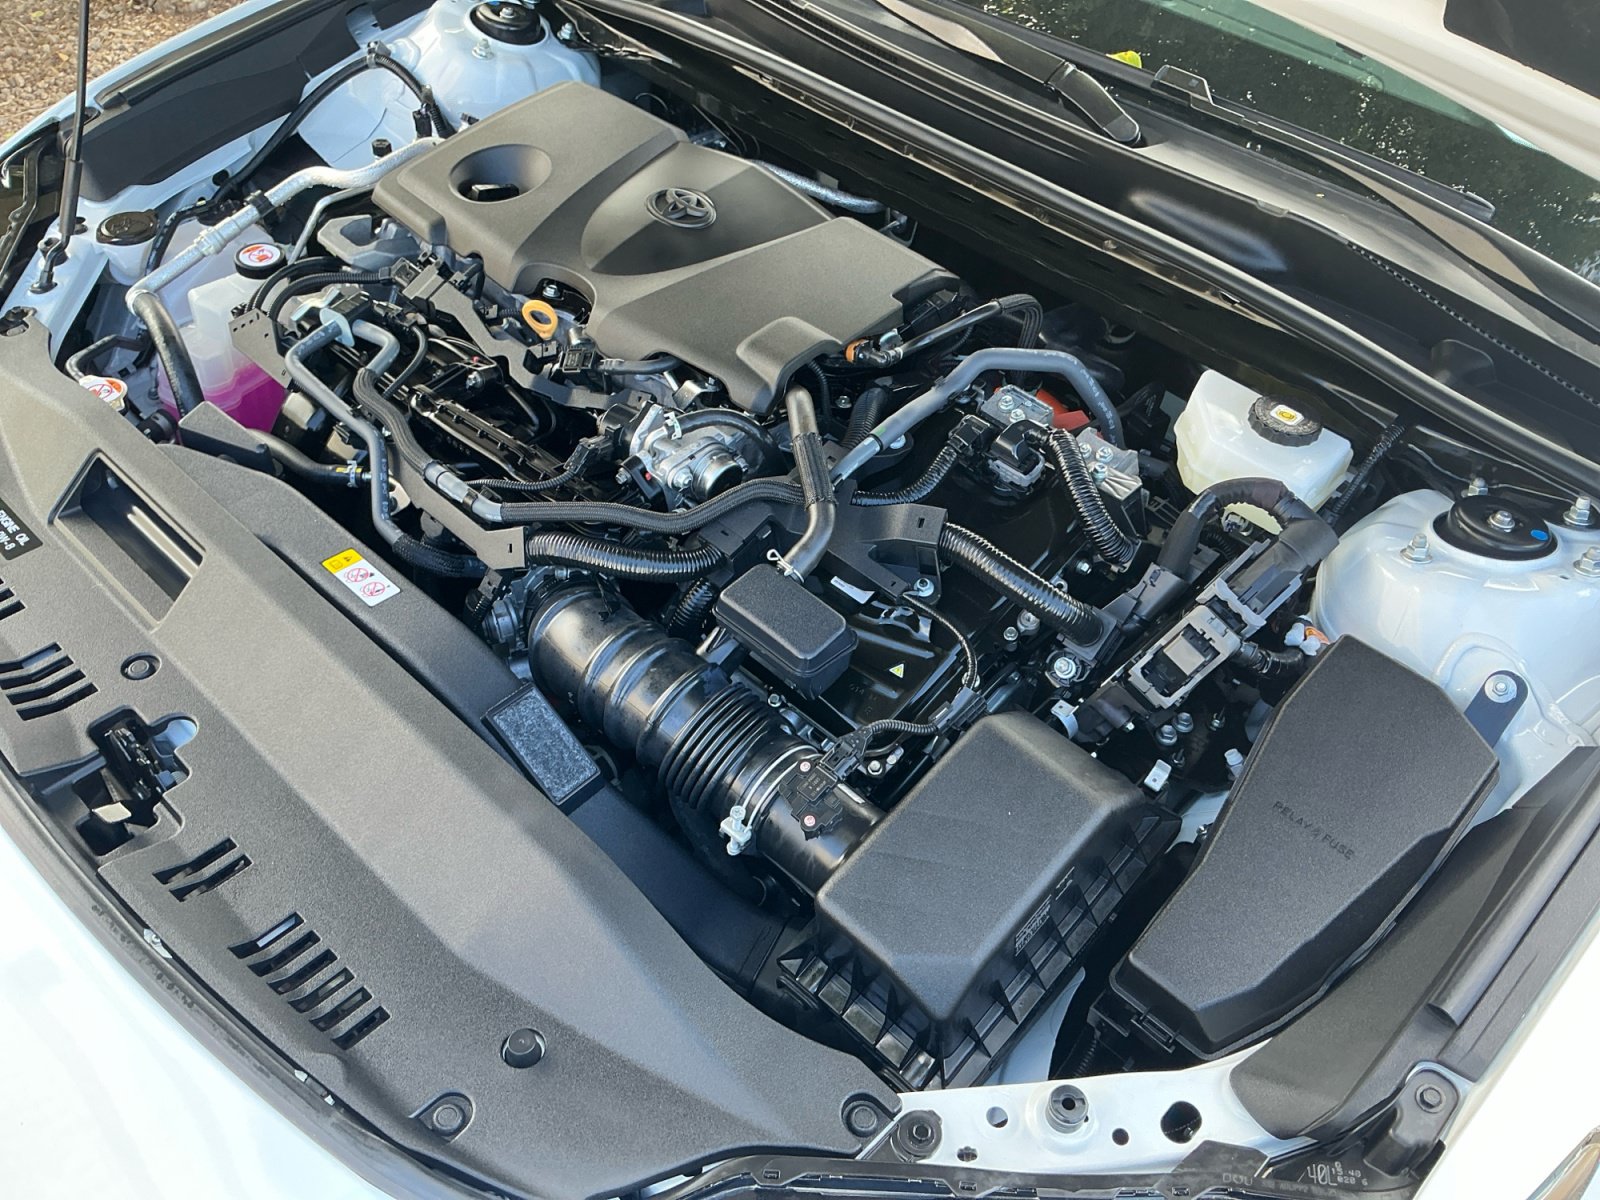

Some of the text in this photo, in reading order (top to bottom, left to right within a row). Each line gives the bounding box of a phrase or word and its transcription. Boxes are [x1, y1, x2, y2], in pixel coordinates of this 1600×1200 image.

[15, 533, 30, 546] OIL
[1273, 801, 1313, 829] RELAY
[1322, 834, 1355, 860] FUSE
